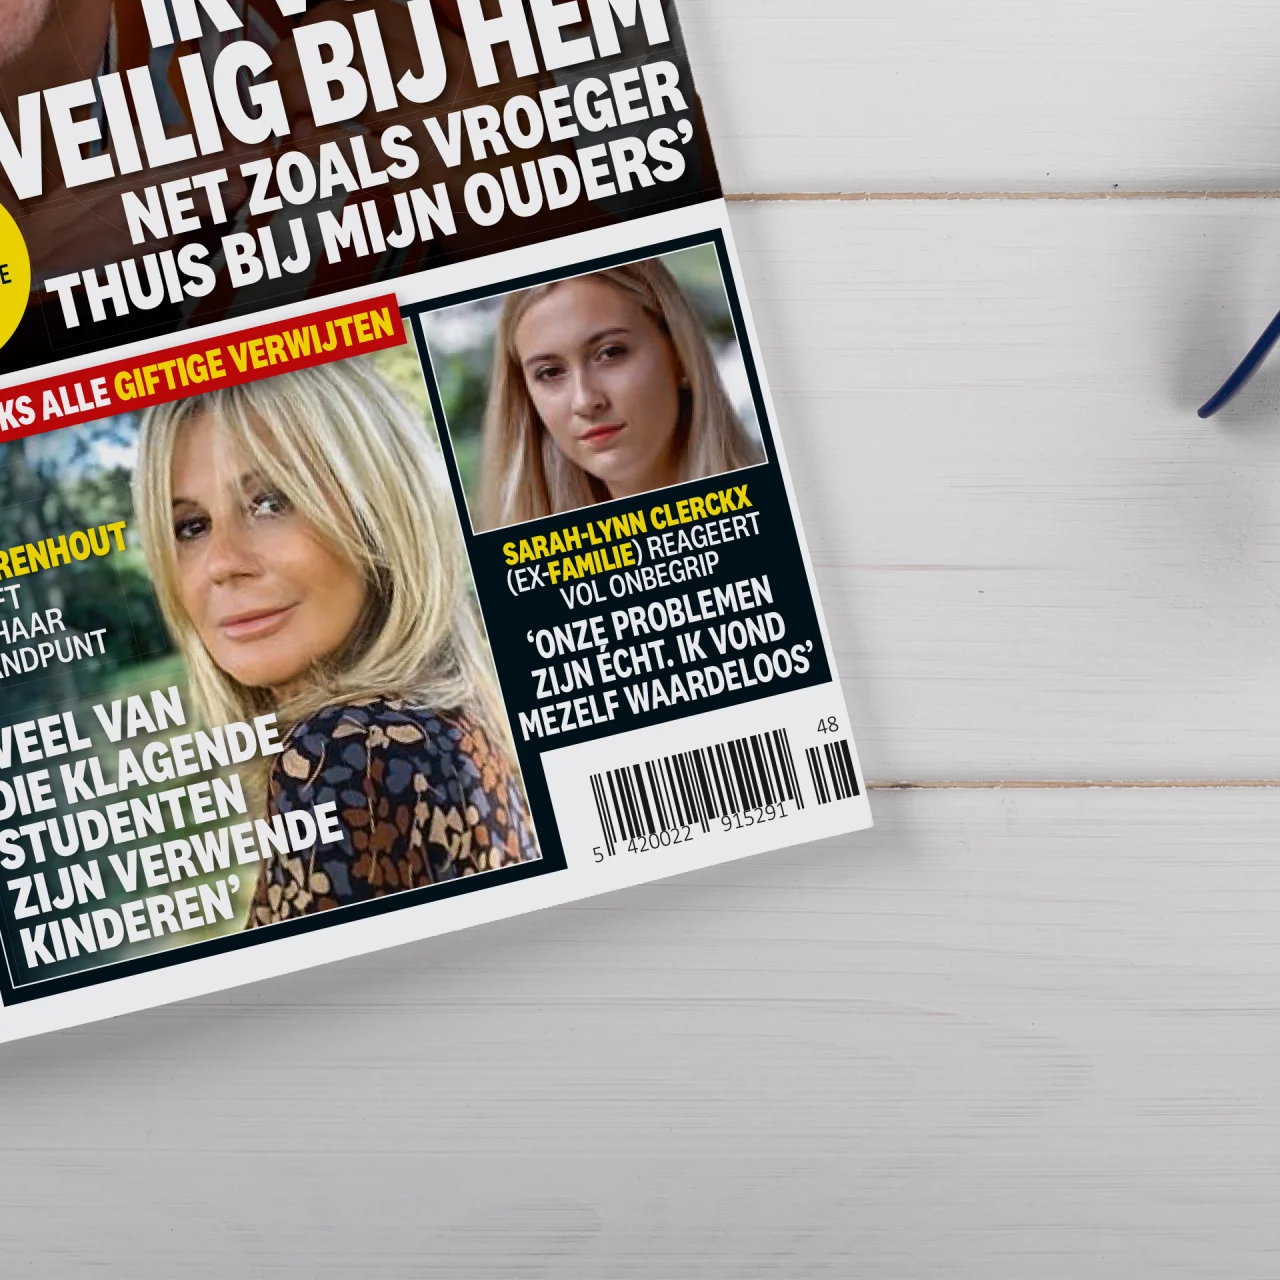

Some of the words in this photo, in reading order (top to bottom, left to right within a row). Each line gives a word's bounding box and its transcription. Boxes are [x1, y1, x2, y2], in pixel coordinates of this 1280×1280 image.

[121, 168, 229, 245] NET
[239, 125, 419, 215] ZOALS
[422, 60, 689, 168] VROEGER
[44, 243, 216, 329] THUIS
[221, 217, 311, 288] BIJ
[317, 182, 457, 264] MIJN
[464, 119, 693, 226] OUDERS’
[42, 377, 111, 421] ALLE
[114, 348, 227, 401] GIFTIGE
[227, 307, 394, 373] VERWIJTEN
[503, 510, 648, 566] SARAH-LYNN
[650, 484, 753, 530] CLERCKX
[507, 538, 643, 597] (EX-FAMILIE)
[646, 511, 760, 560] REAGEERT
[526, 615, 609, 659] ‘ONZE
[611, 575, 774, 641] PROBLEMEN
[531, 657, 594, 700] ZIJN
[596, 639, 674, 683] ÉCHT.
[676, 630, 708, 664] IK
[707, 611, 786, 655] VOND
[92, 685, 186, 743] VAN
[518, 689, 619, 741] MEZELF
[623, 639, 813, 715] WAARDELOOS’
[817, 716, 839, 734] 48
[59, 713, 284, 804] KLAGENDE
[7, 860, 106, 919] ZIJN
[108, 801, 344, 892] VERWENDE
[592, 846, 605, 864] 5
[625, 824, 694, 856] 420022
[720, 801, 789, 832] 915291
[19, 874, 240, 968] KINDEREN’
